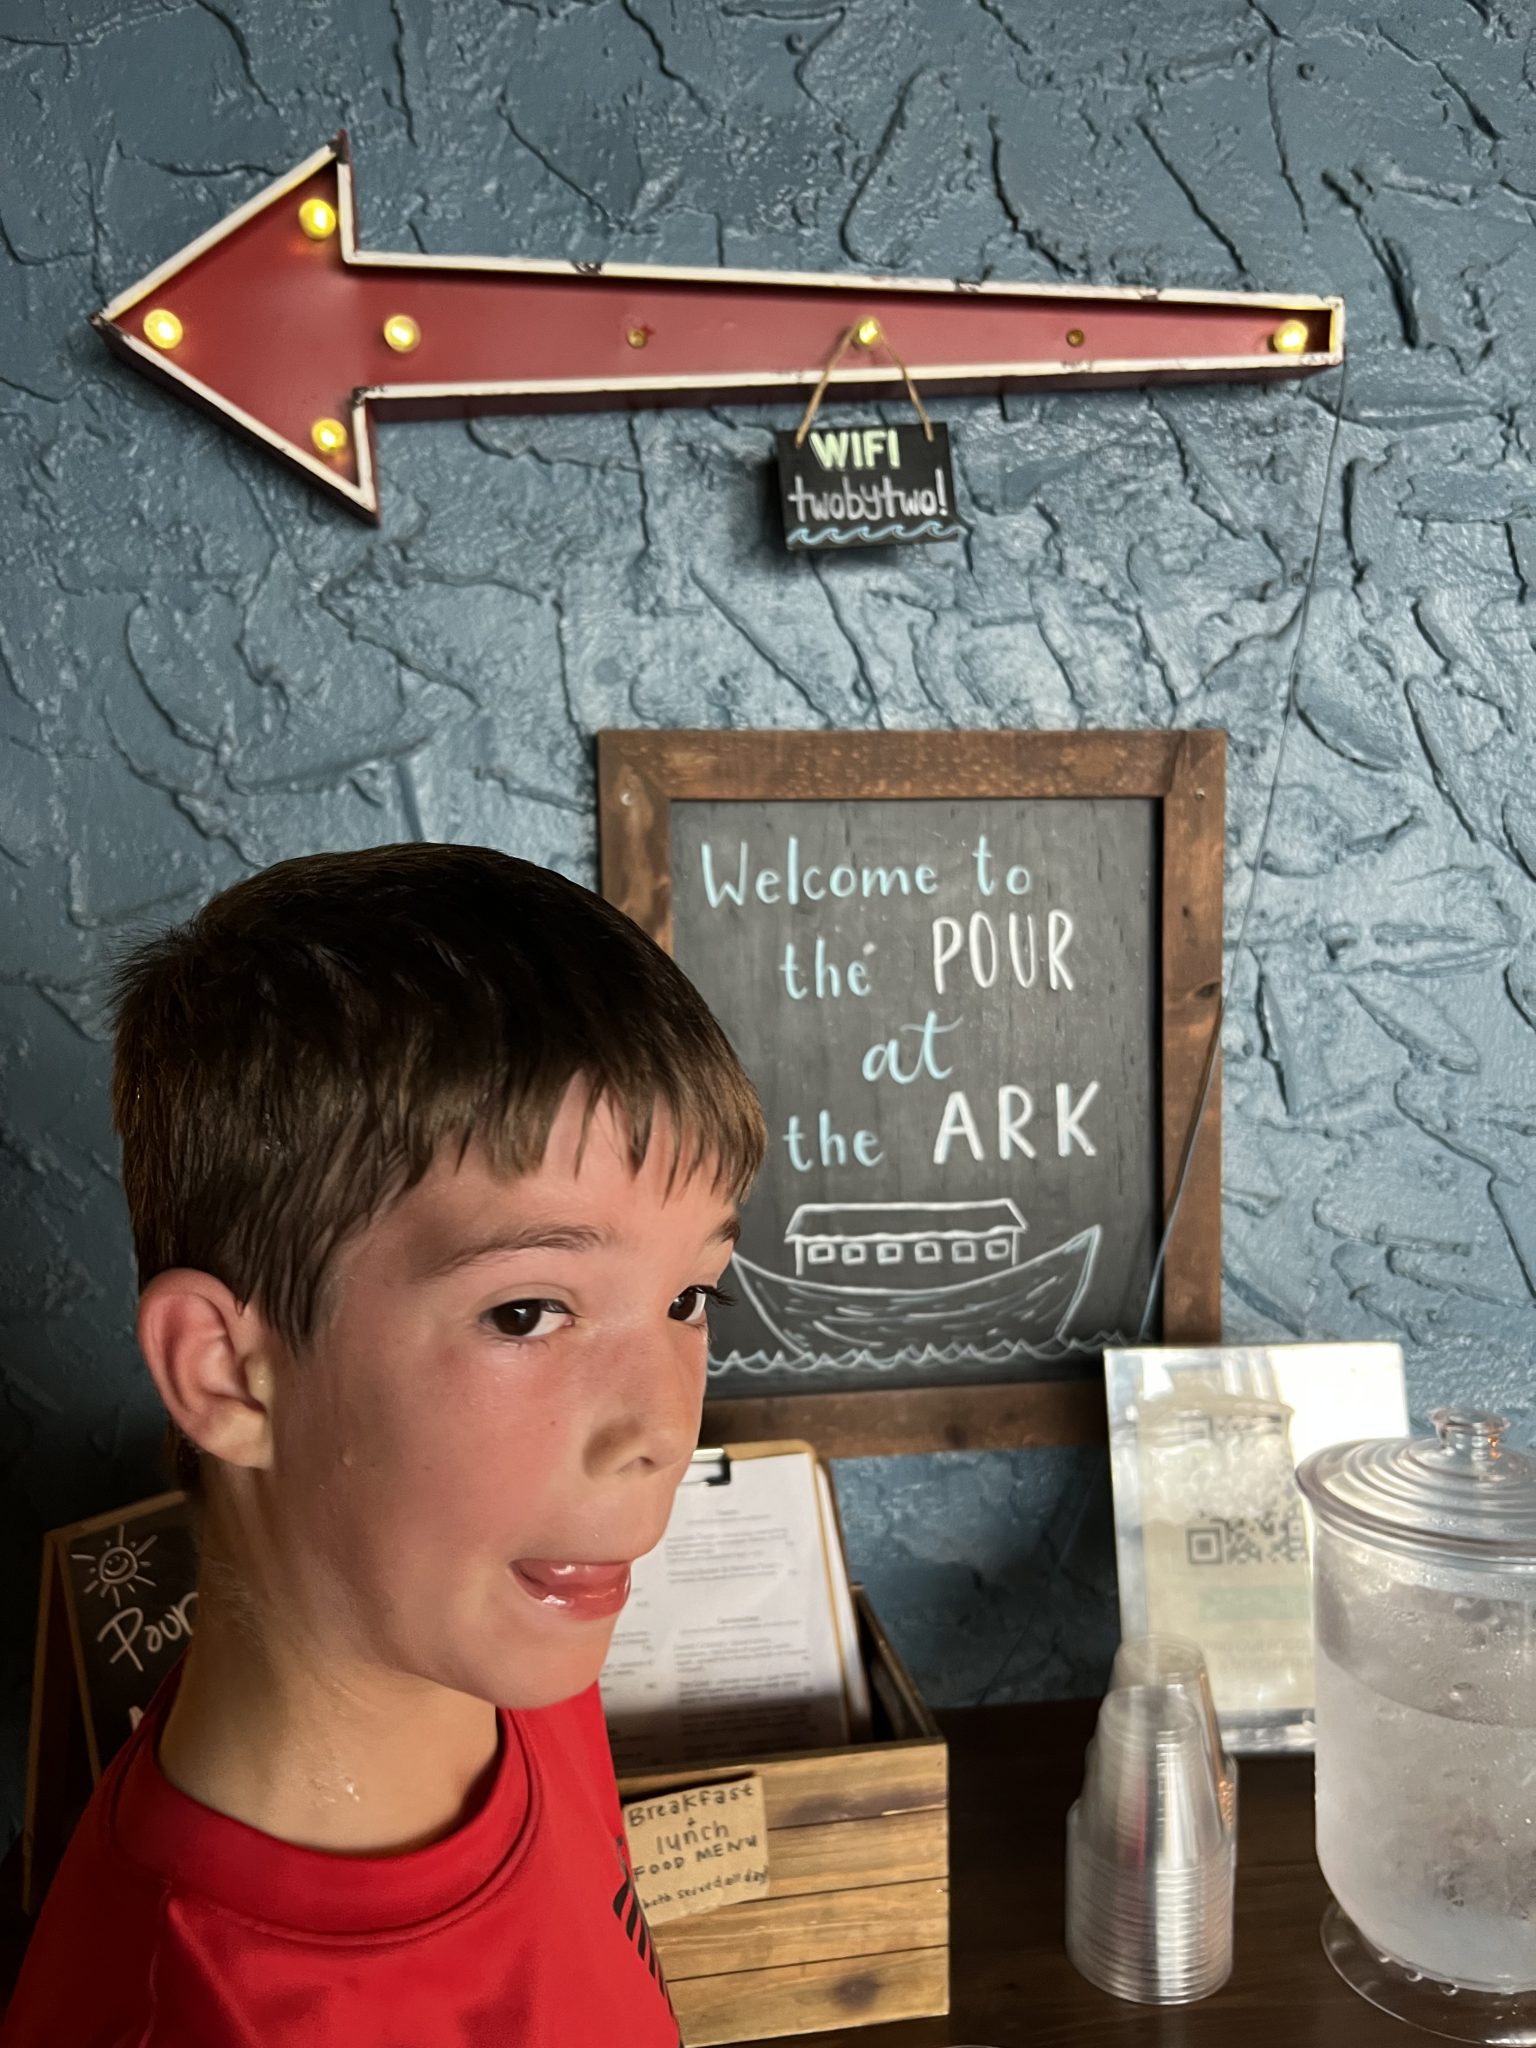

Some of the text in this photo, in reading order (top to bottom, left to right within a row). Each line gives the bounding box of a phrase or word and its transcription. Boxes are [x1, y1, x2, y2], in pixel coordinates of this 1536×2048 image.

[810, 429, 901, 471] WIFI
[787, 465, 949, 523] twobytwo!
[702, 834, 1032, 908] Welcome to
[779, 909, 1075, 1000] the POUR
[861, 1010, 964, 1085] at
[782, 1081, 1100, 1172] the ARK
[97, 1591, 199, 1672] Pour
[628, 1783, 754, 1828] Breakfast
[696, 1834, 758, 1863] MENU
